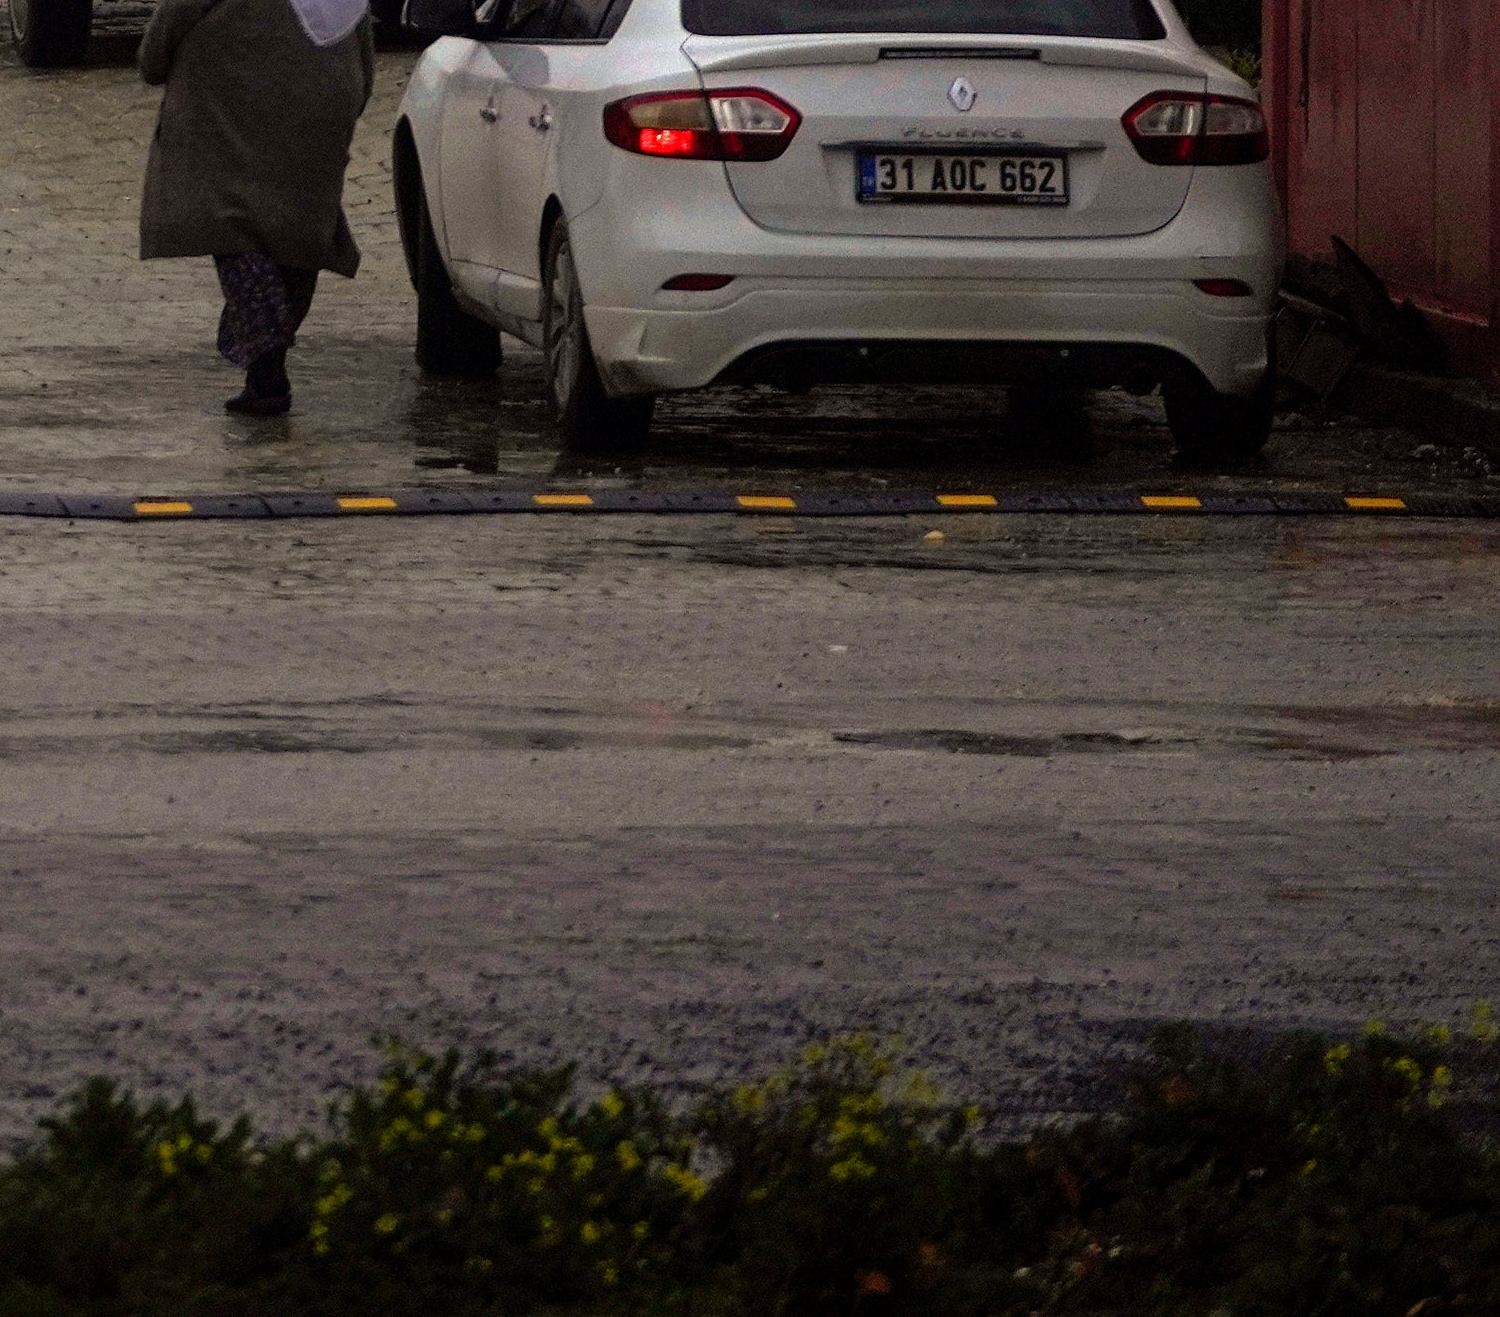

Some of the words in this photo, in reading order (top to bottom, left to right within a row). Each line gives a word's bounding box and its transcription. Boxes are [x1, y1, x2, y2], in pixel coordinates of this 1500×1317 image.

[903, 127, 1025, 139] FLUENCE
[879, 158, 914, 192] 31
[931, 159, 987, 192] AOC
[999, 160, 1057, 194] 662
